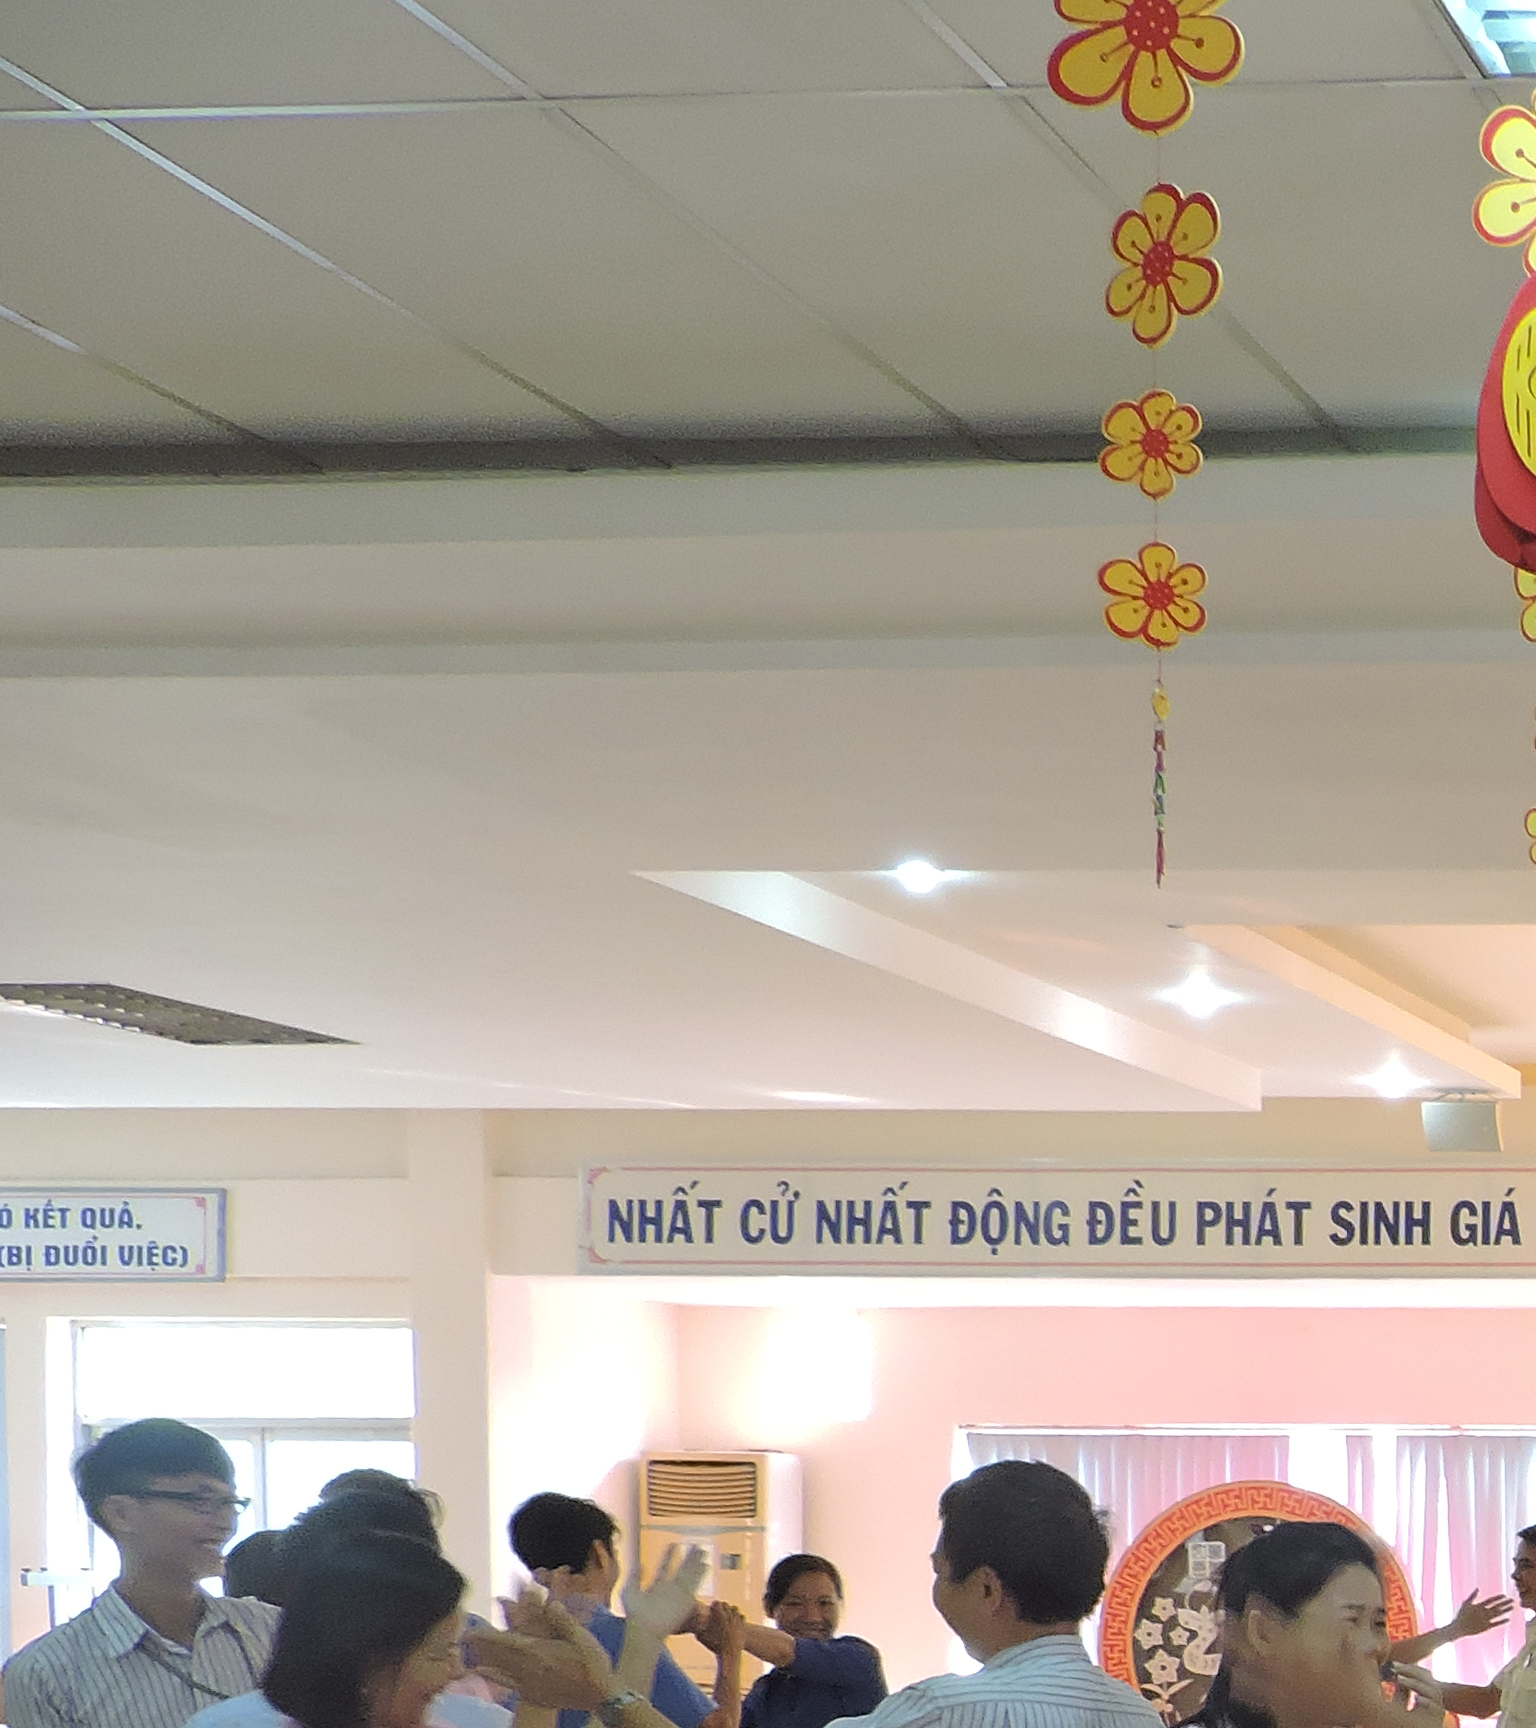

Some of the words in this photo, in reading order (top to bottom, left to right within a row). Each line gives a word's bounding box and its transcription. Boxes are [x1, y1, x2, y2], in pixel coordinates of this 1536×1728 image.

[0, 1202, 13, 1229] Ó
[24, 1199, 71, 1229] KẾT
[80, 1201, 143, 1229] QUẢ.
[607, 1180, 723, 1245] NHẤT
[739, 1180, 801, 1245] CỬ
[815, 1180, 932, 1246] NHẤT
[948, 1187, 1072, 1256] ĐỘNG
[1085, 1178, 1178, 1247] ĐỀU
[1196, 1187, 1312, 1247] PHÁT
[1328, 1199, 1432, 1247] SINH
[1449, 1187, 1522, 1247] GIÁ
[43, 1235, 108, 1267] ĐUỔI
